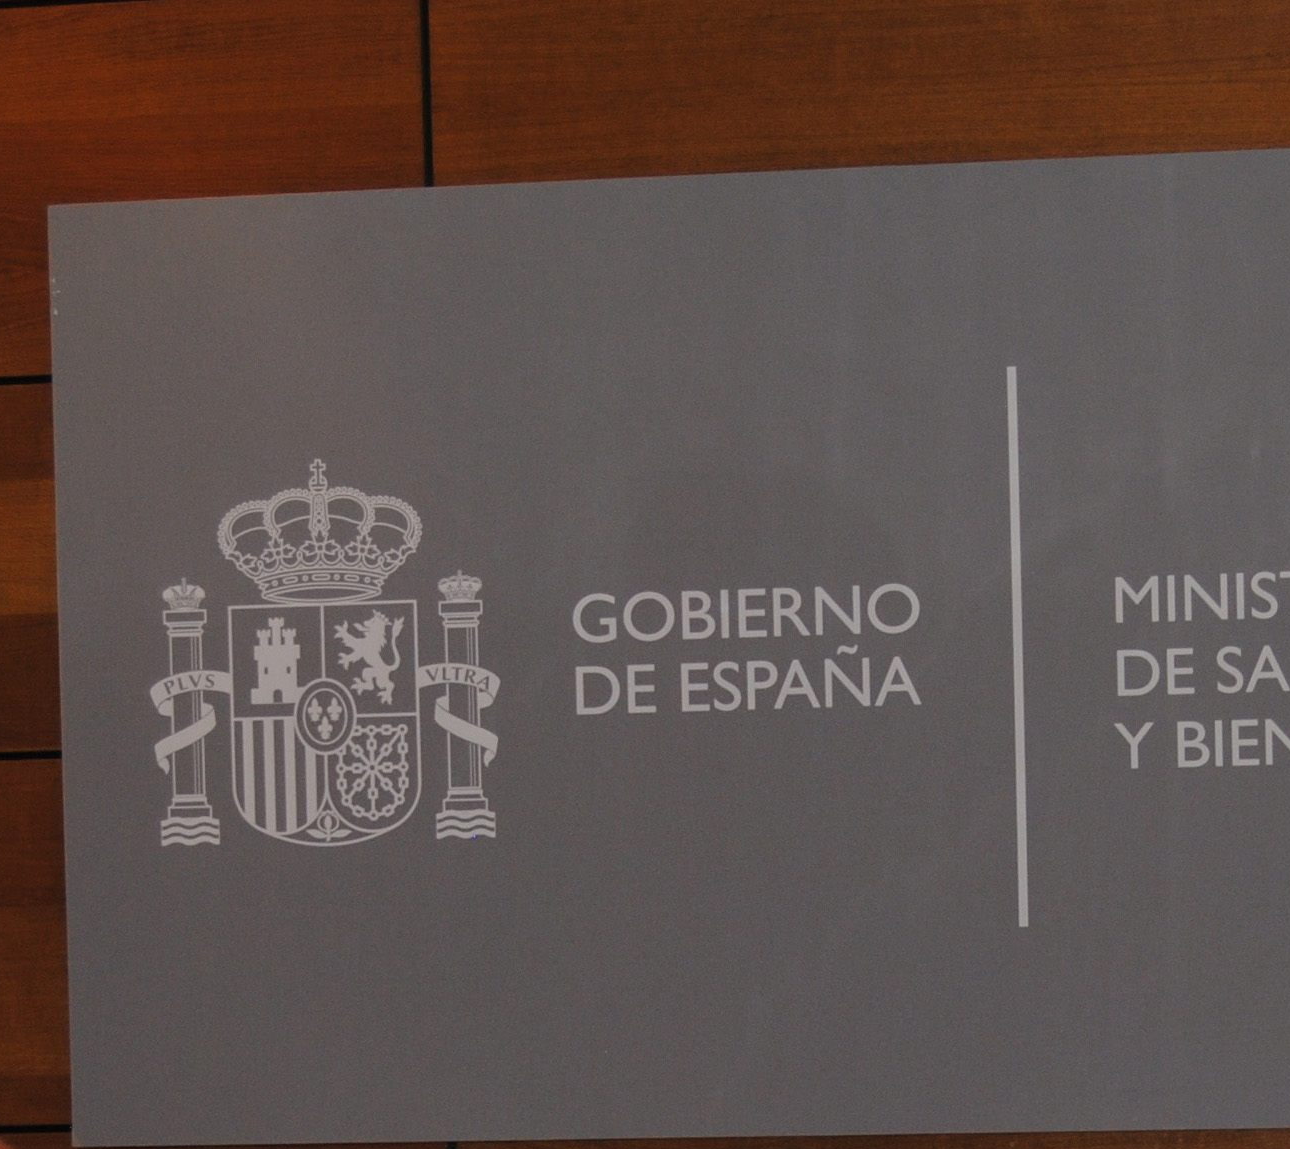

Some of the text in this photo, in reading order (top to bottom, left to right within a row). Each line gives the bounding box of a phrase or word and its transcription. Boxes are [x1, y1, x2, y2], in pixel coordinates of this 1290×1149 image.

[572, 582, 921, 643] GOBIERNO
[163, 673, 215, 695] PLVS
[425, 666, 489, 690] VLTRA
[574, 644, 922, 715] DE ESPAÑA
[1116, 648, 1195, 697] DE
[1114, 721, 1154, 769] Y
